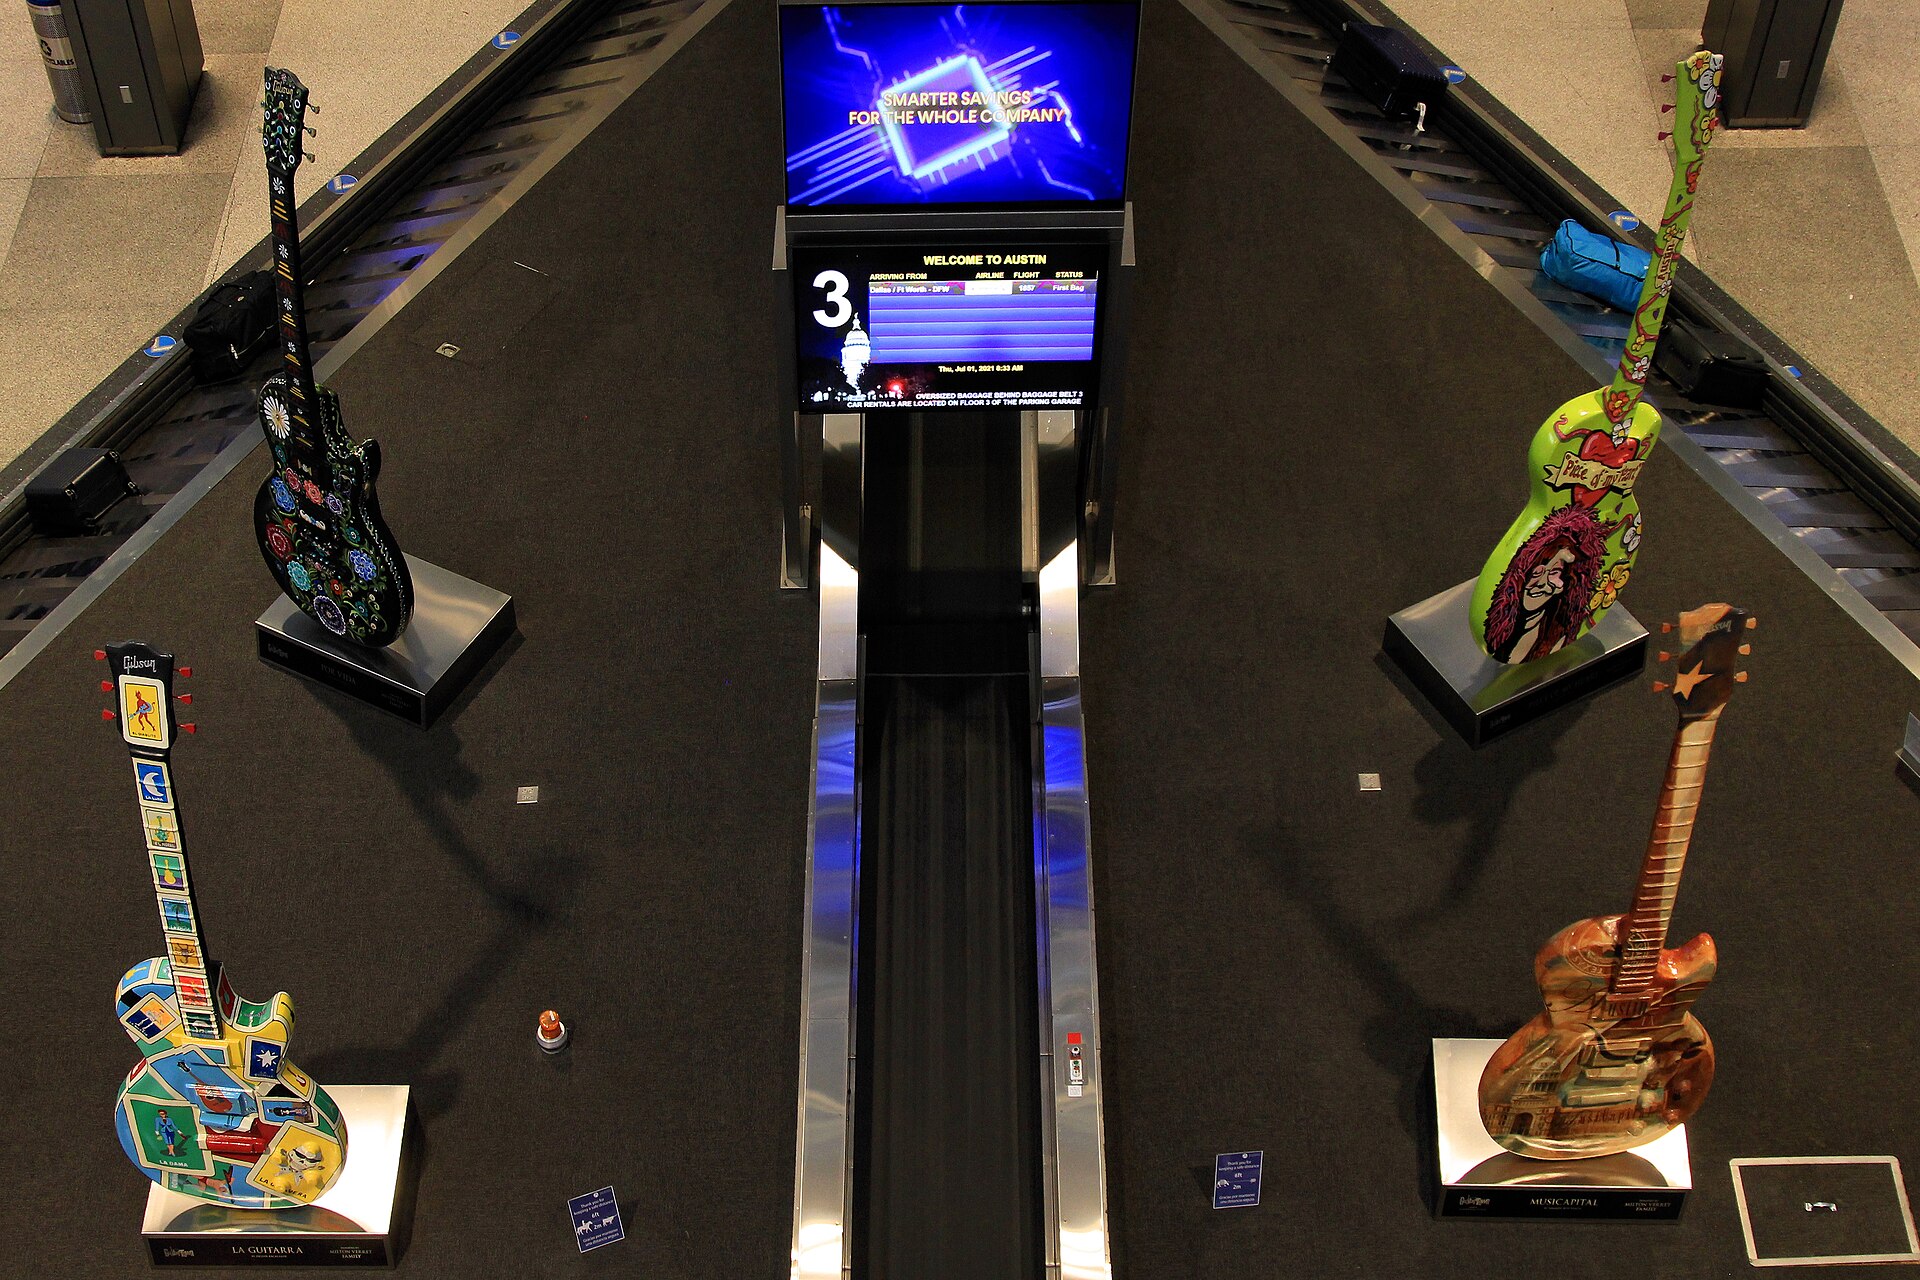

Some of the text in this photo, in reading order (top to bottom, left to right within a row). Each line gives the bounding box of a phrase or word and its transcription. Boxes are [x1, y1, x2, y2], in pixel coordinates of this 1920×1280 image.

[884, 91, 1030, 106] SMARTER SAVINGS
[849, 108, 1065, 125] FOR THE WHOLE COMPANY
[924, 254, 1046, 265] WELCOME TO AUSTIN
[812, 270, 852, 328] 3
[123, 656, 157, 674] Gibson
[1530, 1198, 1599, 1207] MUSICAPITAL
